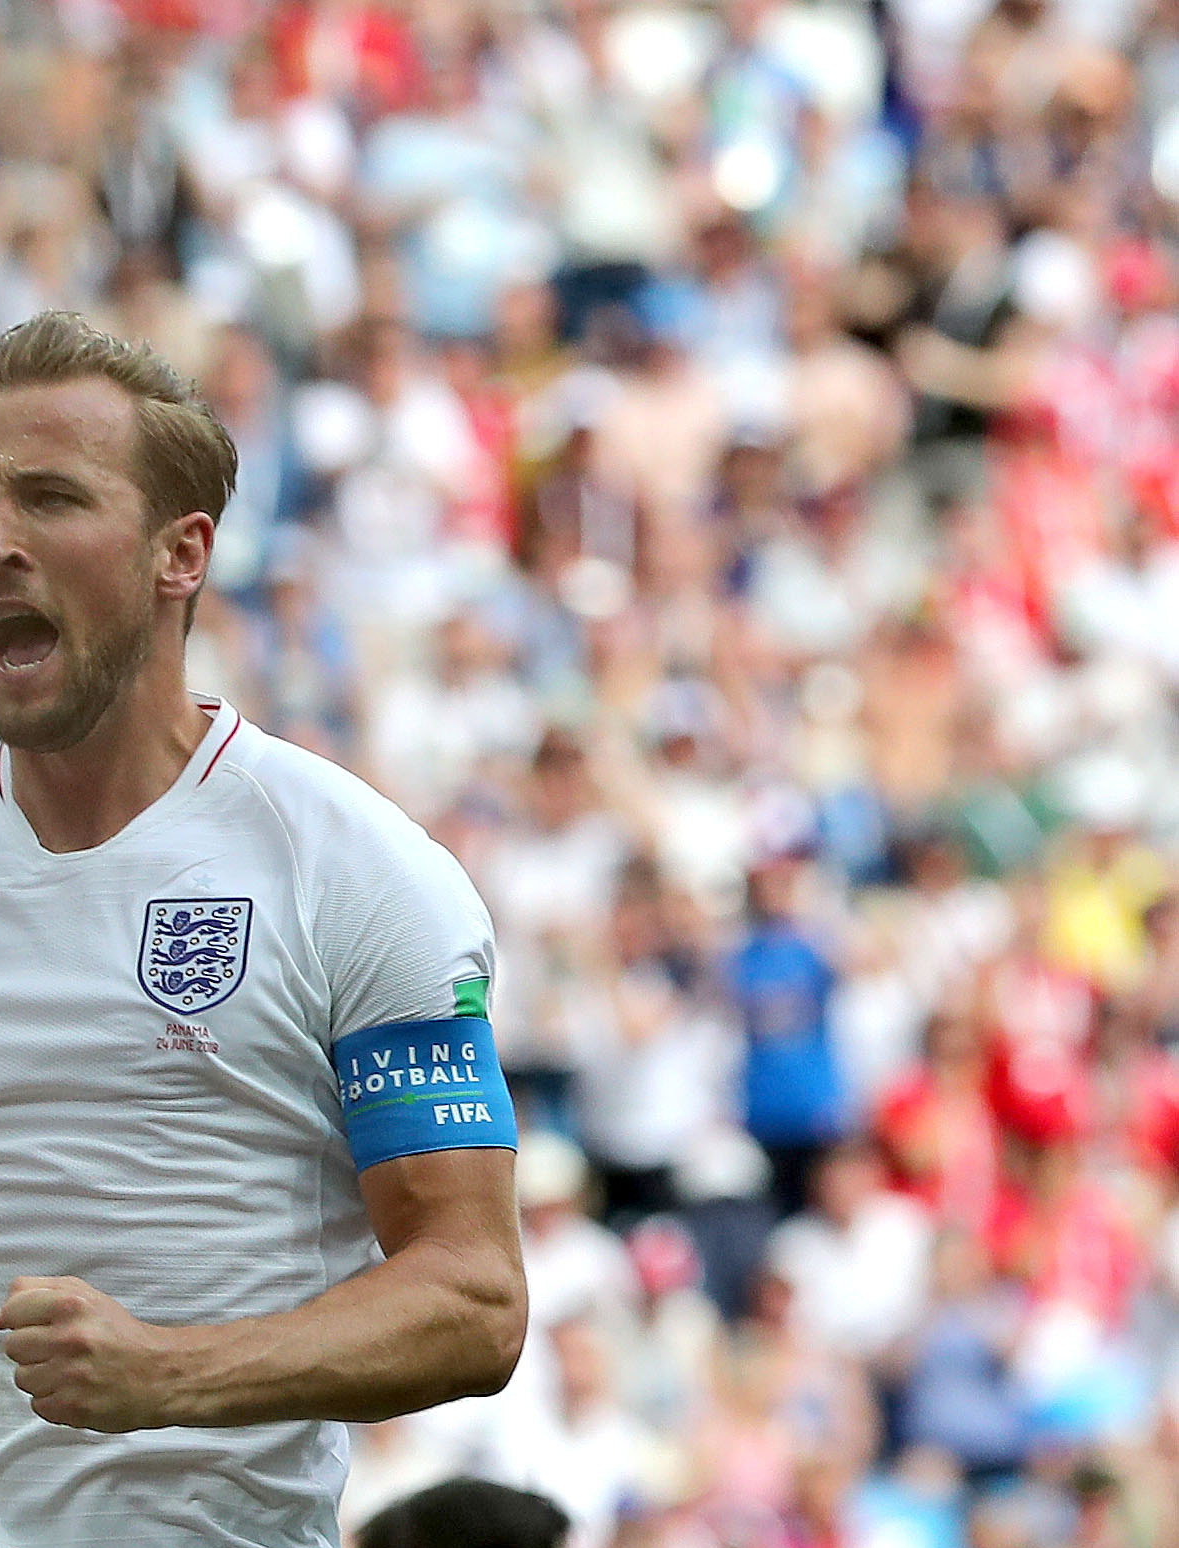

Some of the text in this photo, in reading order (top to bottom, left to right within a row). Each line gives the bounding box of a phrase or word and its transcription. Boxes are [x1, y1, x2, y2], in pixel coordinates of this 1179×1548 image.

[166, 1023, 209, 1037] PANAMA
[156, 1037, 168, 1050] 24
[171, 1038, 194, 1051] JUNE
[351, 1042, 476, 1076] IVING
[433, 1103, 493, 1125] FIFA
